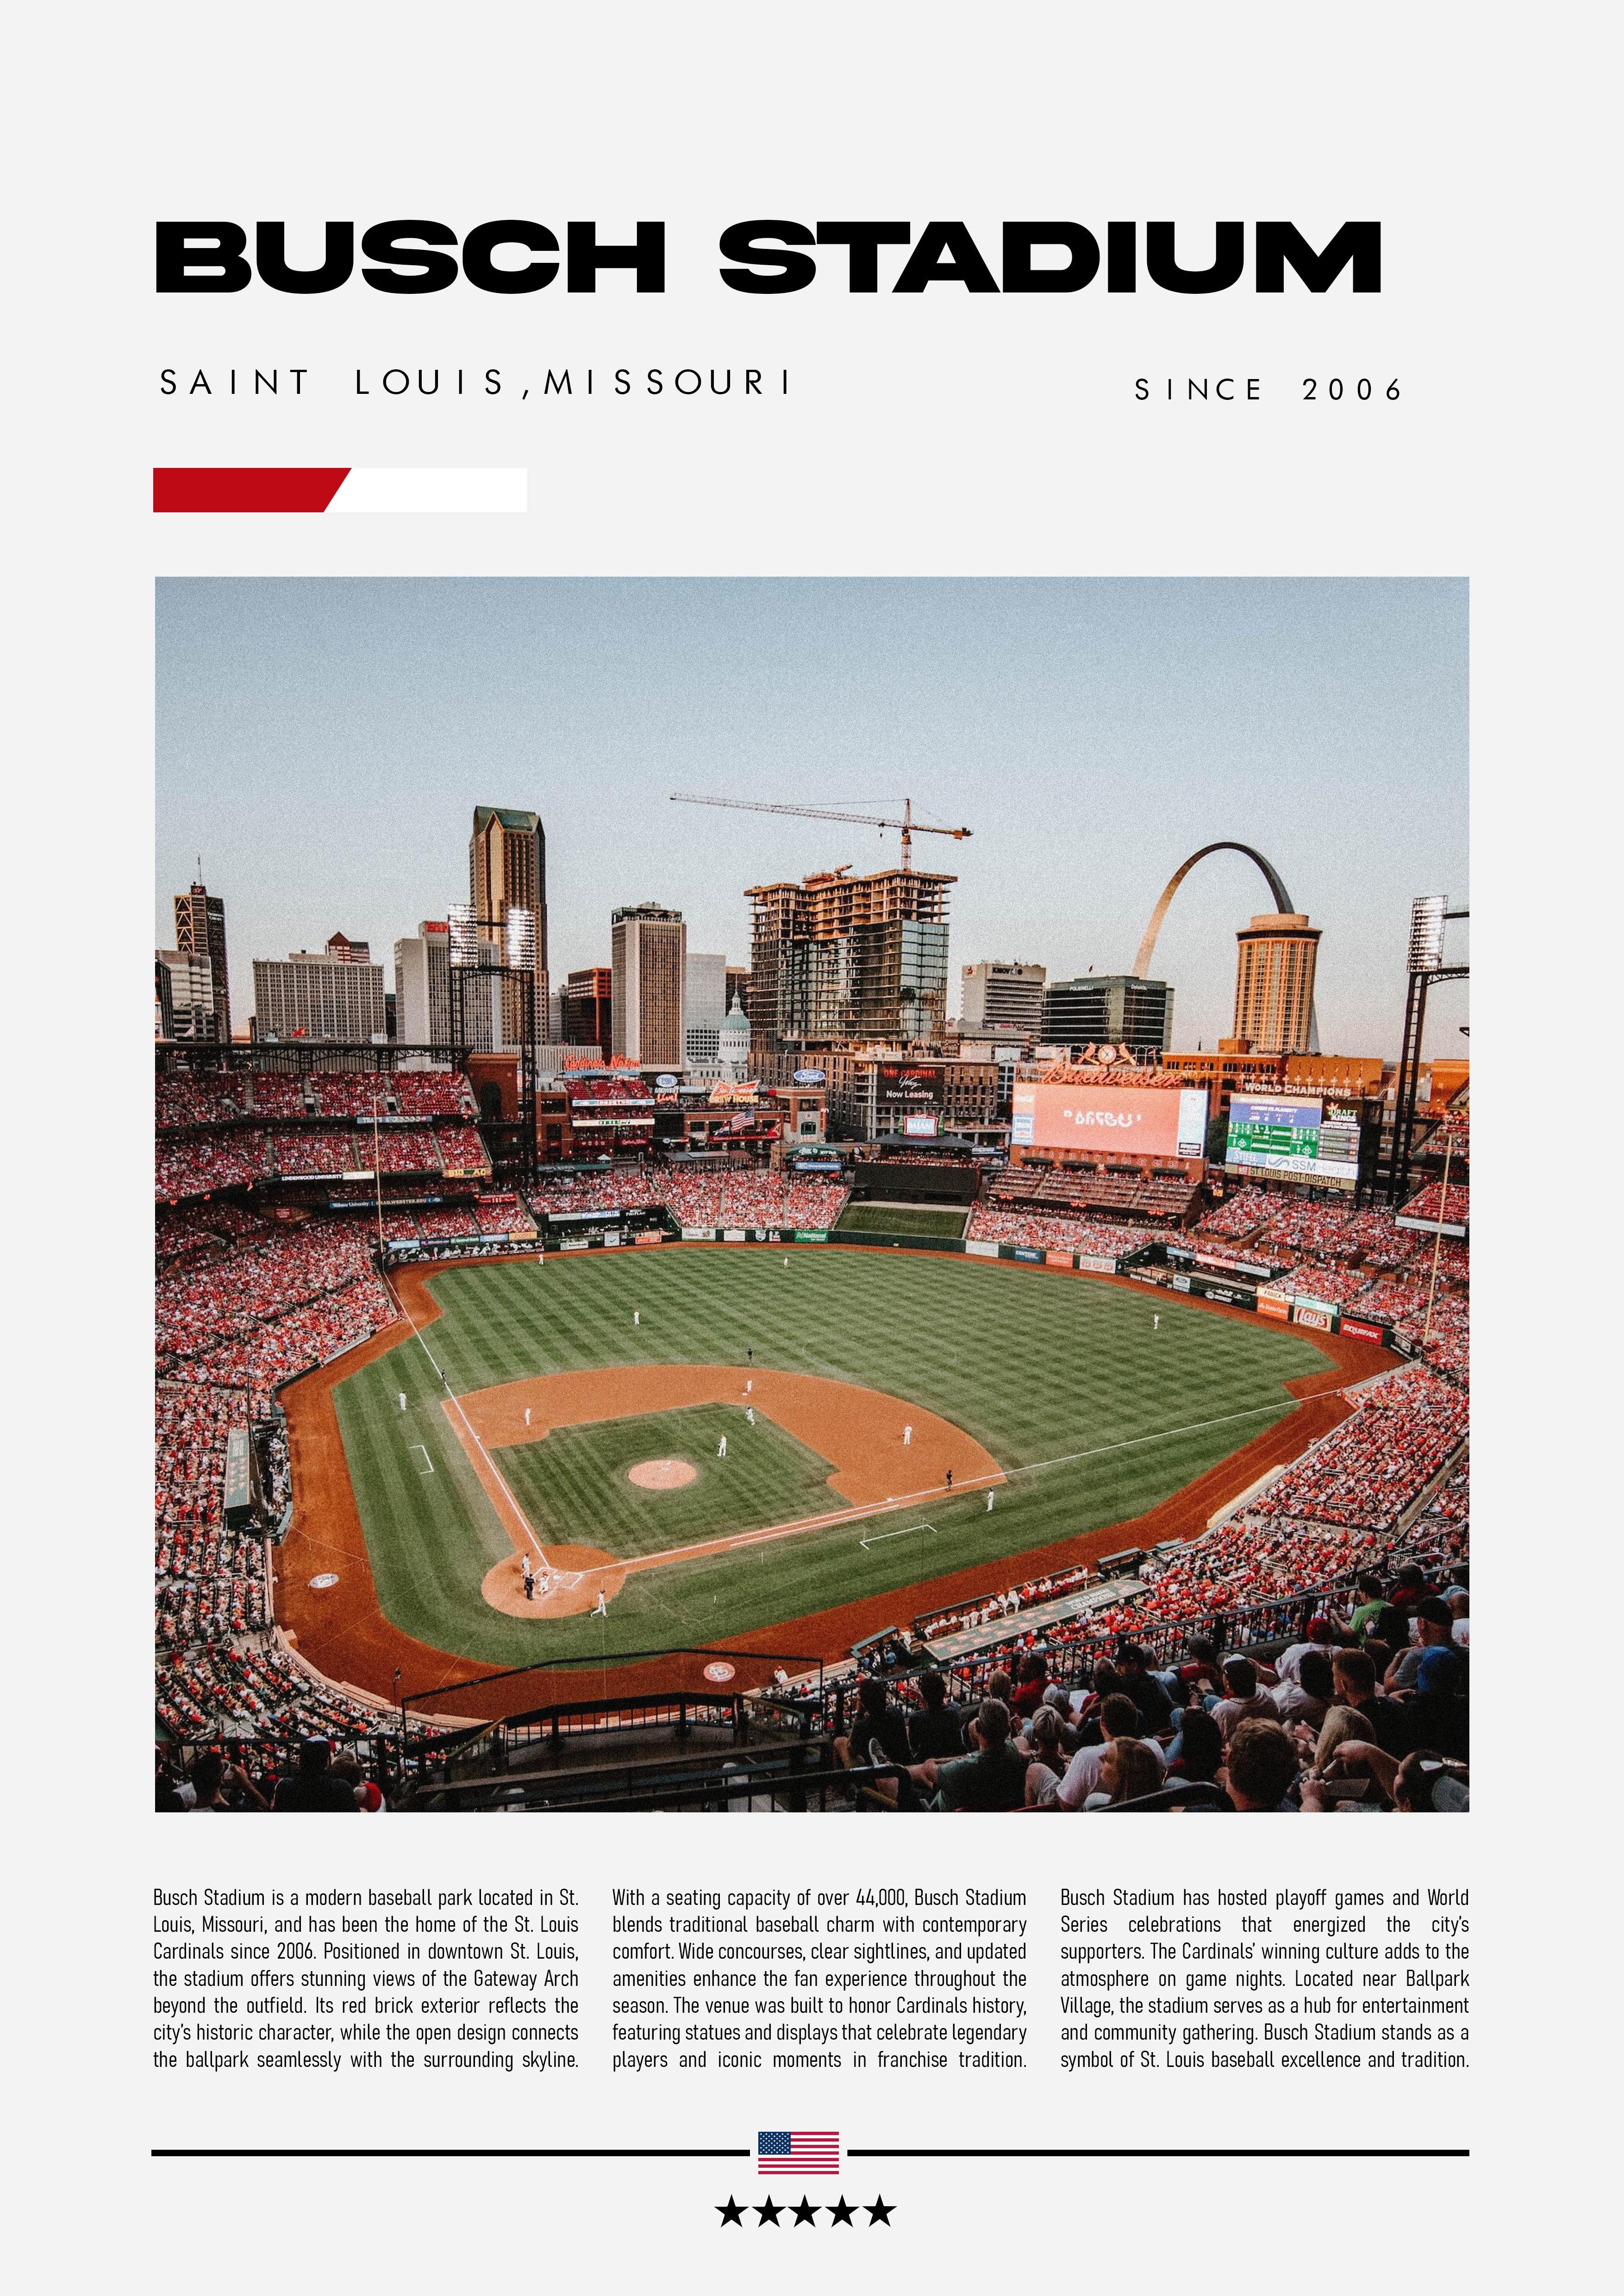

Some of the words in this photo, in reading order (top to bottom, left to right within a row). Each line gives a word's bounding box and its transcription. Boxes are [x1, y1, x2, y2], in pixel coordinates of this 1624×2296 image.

[564, 1055, 605, 1070] Cardinals
[606, 1054, 641, 1070] Nation
[1037, 1061, 1183, 1088] Budweiser
[905, 1090, 933, 1100] Leasing
[1245, 1082, 1282, 1093] WORLD
[1284, 1084, 1351, 1096] CHAMPIONS
[734, 1095, 759, 1103] HOUSE
[1292, 1160, 1317, 1171] SSM
[1261, 1169, 1281, 1179] LOUIS
[1283, 1171, 1341, 1187] POST-DISPATCH
[1298, 1308, 1327, 1326] Lay's
[1343, 1324, 1379, 1339] EQUIFAX
